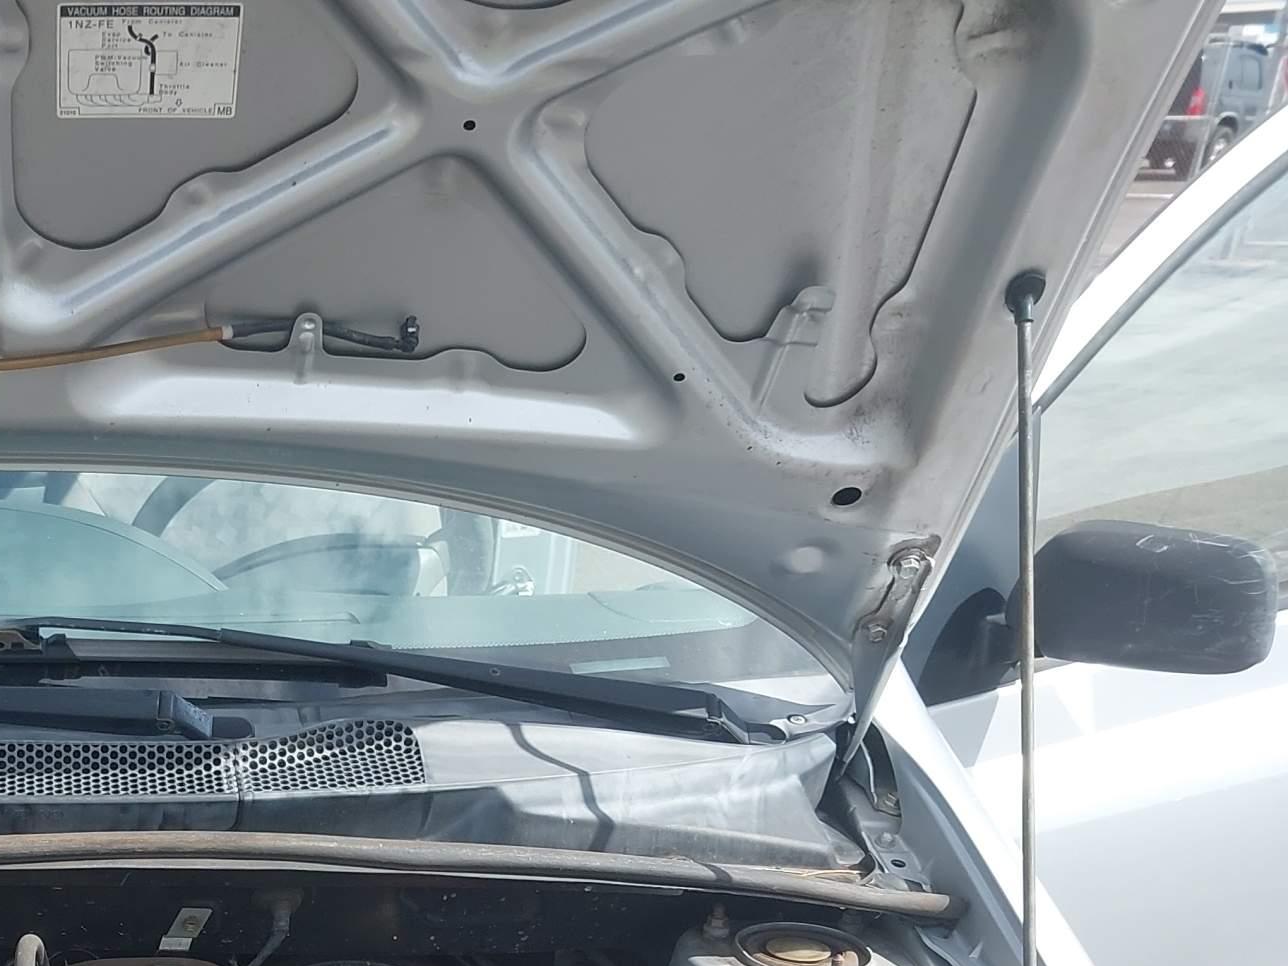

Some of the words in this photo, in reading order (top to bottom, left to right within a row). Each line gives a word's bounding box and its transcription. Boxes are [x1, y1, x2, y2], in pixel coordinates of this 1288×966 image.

[67, 7, 107, 16] VACUUM
[113, 7, 138, 16] HOSE
[143, 7, 185, 16] ROUTING
[191, 7, 234, 16] DIAGRAM
[68, 20, 115, 29] 1NZ-FE
[217, 106, 232, 115] MB
